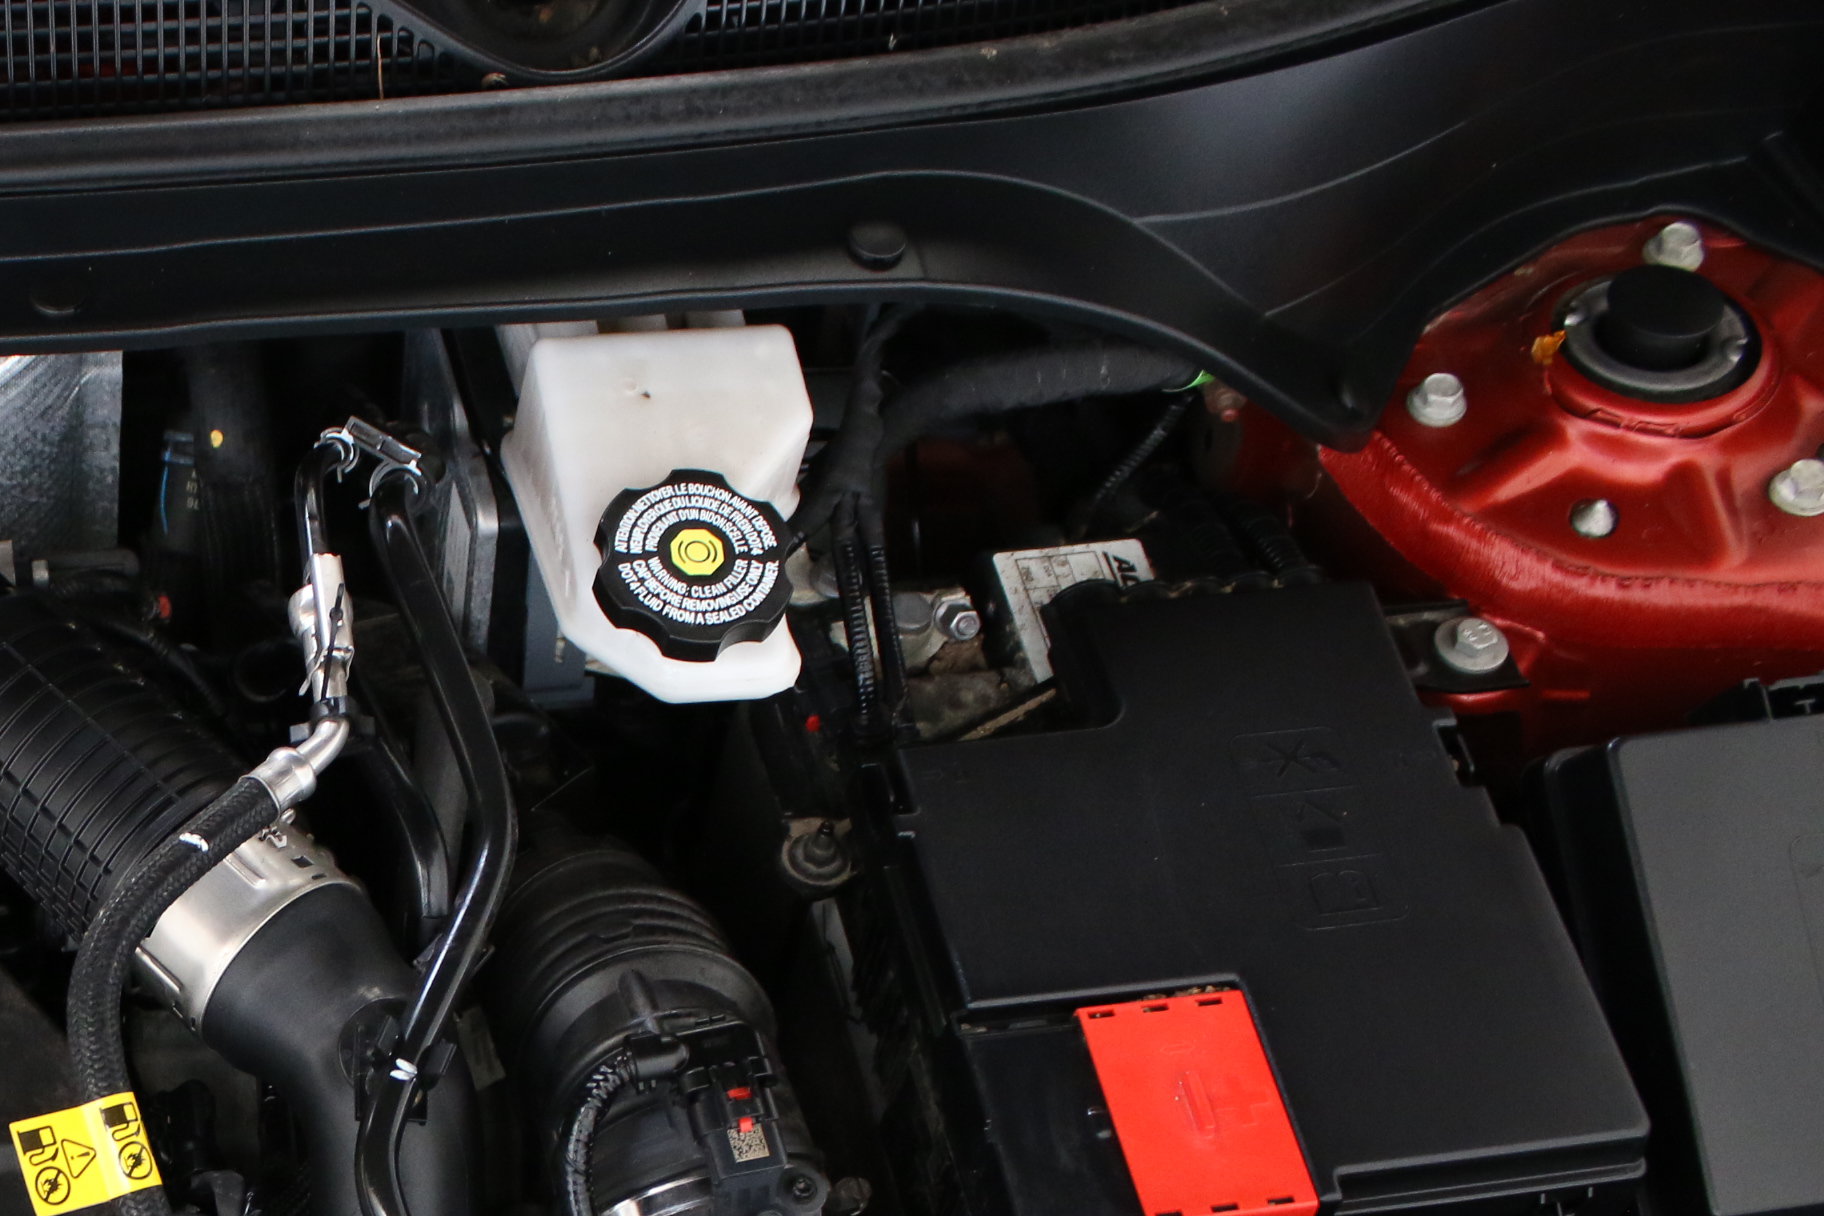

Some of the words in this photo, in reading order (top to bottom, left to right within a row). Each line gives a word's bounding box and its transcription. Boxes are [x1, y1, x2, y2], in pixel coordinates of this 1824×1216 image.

[672, 495, 686, 509] DU
[685, 495, 722, 513] LIQUIDE
[719, 503, 735, 518] DE
[729, 510, 755, 535] FREIN
[674, 483, 688, 496] LE
[687, 483, 732, 504] BOUCHON
[728, 495, 760, 520] AVANT
[699, 509, 728, 529] BIDON
[632, 559, 652, 580] CAP
[643, 577, 683, 608] BEFORE
[734, 580, 755, 601] USE
[745, 560, 764, 586] ONLY
[690, 581, 728, 599] CLEAN
[723, 559, 748, 590] FILLER
[633, 585, 665, 612] FLUID
[662, 604, 695, 624] FROM
[695, 611, 706, 626] A
[704, 604, 747, 625] SEALED
